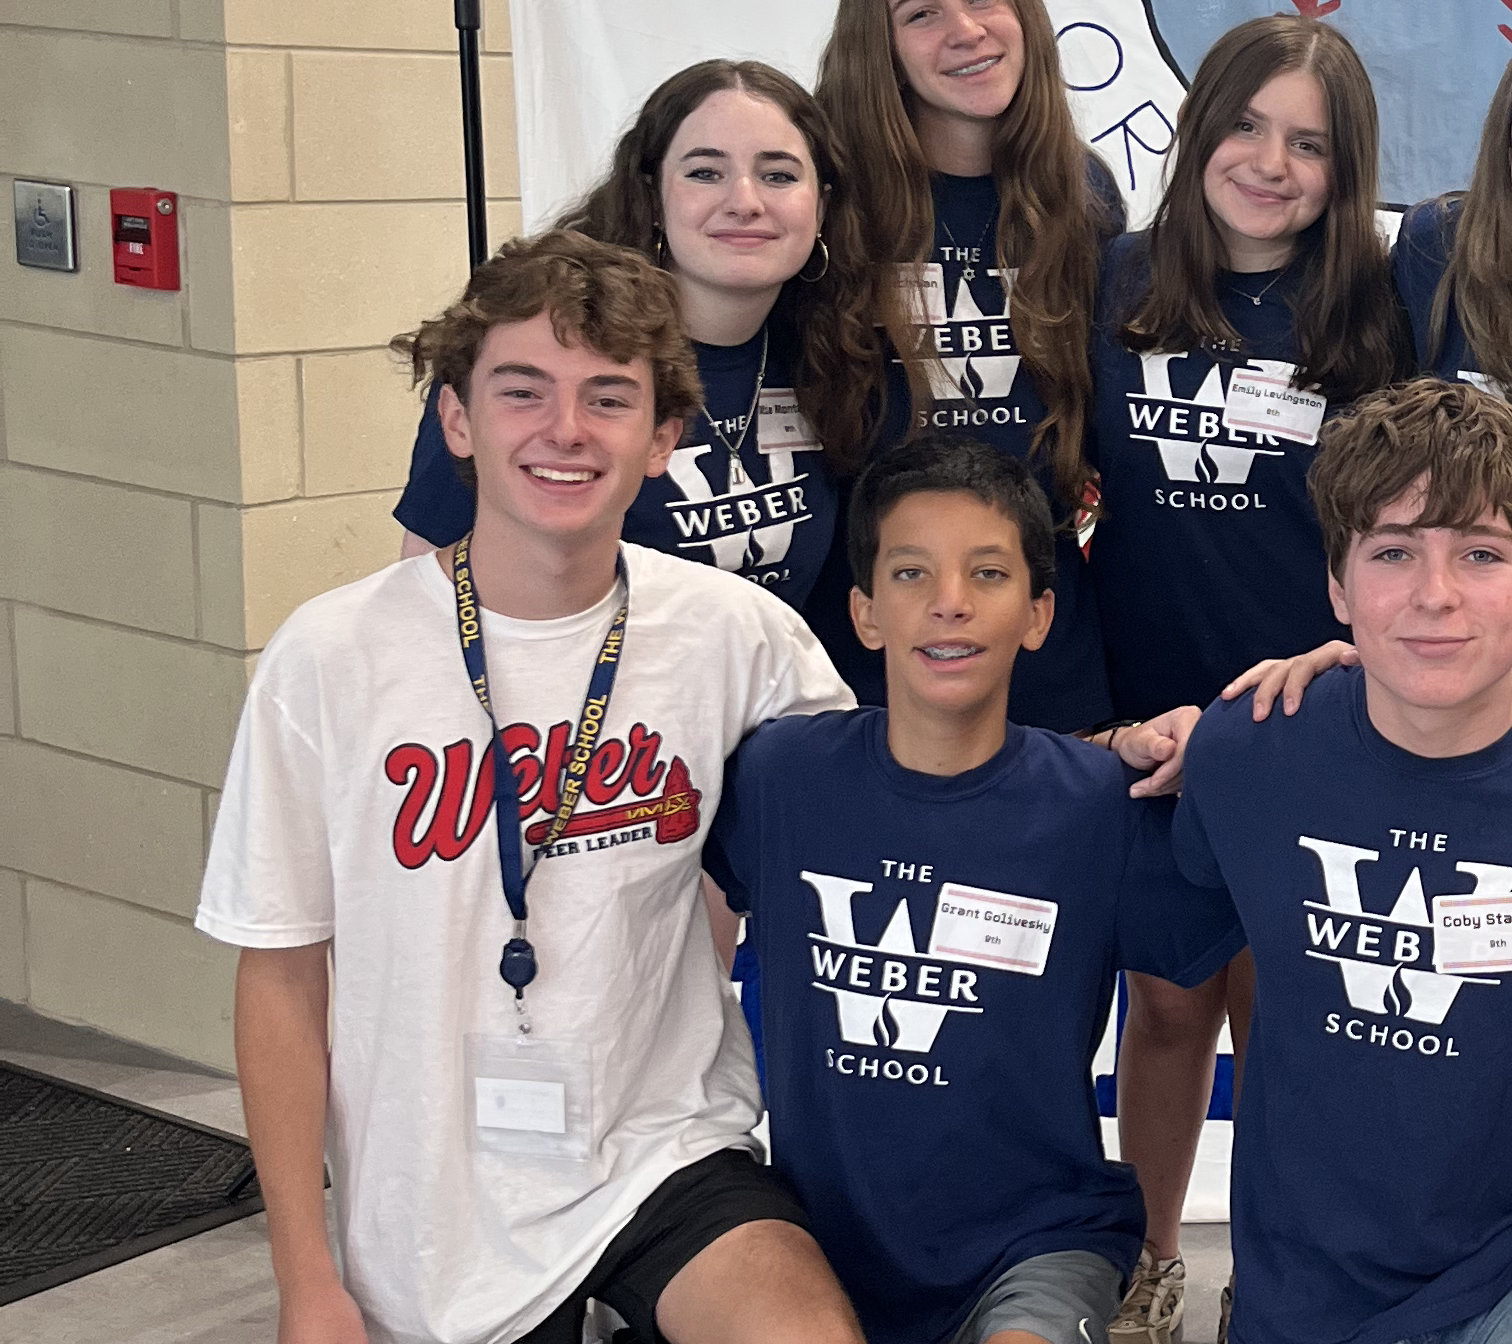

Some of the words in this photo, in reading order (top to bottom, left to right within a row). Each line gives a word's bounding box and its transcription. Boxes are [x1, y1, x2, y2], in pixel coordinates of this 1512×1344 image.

[129, 242, 144, 255] FIRE
[940, 247, 982, 262] THE
[1231, 383, 1262, 398] Emily
[917, 407, 1027, 428] SCHOOL
[672, 486, 808, 538] WEBER
[1154, 488, 1267, 511] SCHOOL
[455, 567, 480, 648] SCHOOL
[598, 628, 624, 664] THE
[542, 777, 584, 846] WEBER
[568, 694, 608, 776] SCHOOL
[586, 826, 653, 852] LEADER
[1388, 828, 1449, 853] THE
[880, 859, 934, 884] THE
[941, 902, 981, 920] Grant
[1443, 914, 1482, 930] Coby
[1306, 913, 1421, 963] WEB
[810, 944, 979, 1003] WEBER
[1325, 1012, 1460, 1058] SCHOOL
[825, 1048, 950, 1087] SCHOOL
